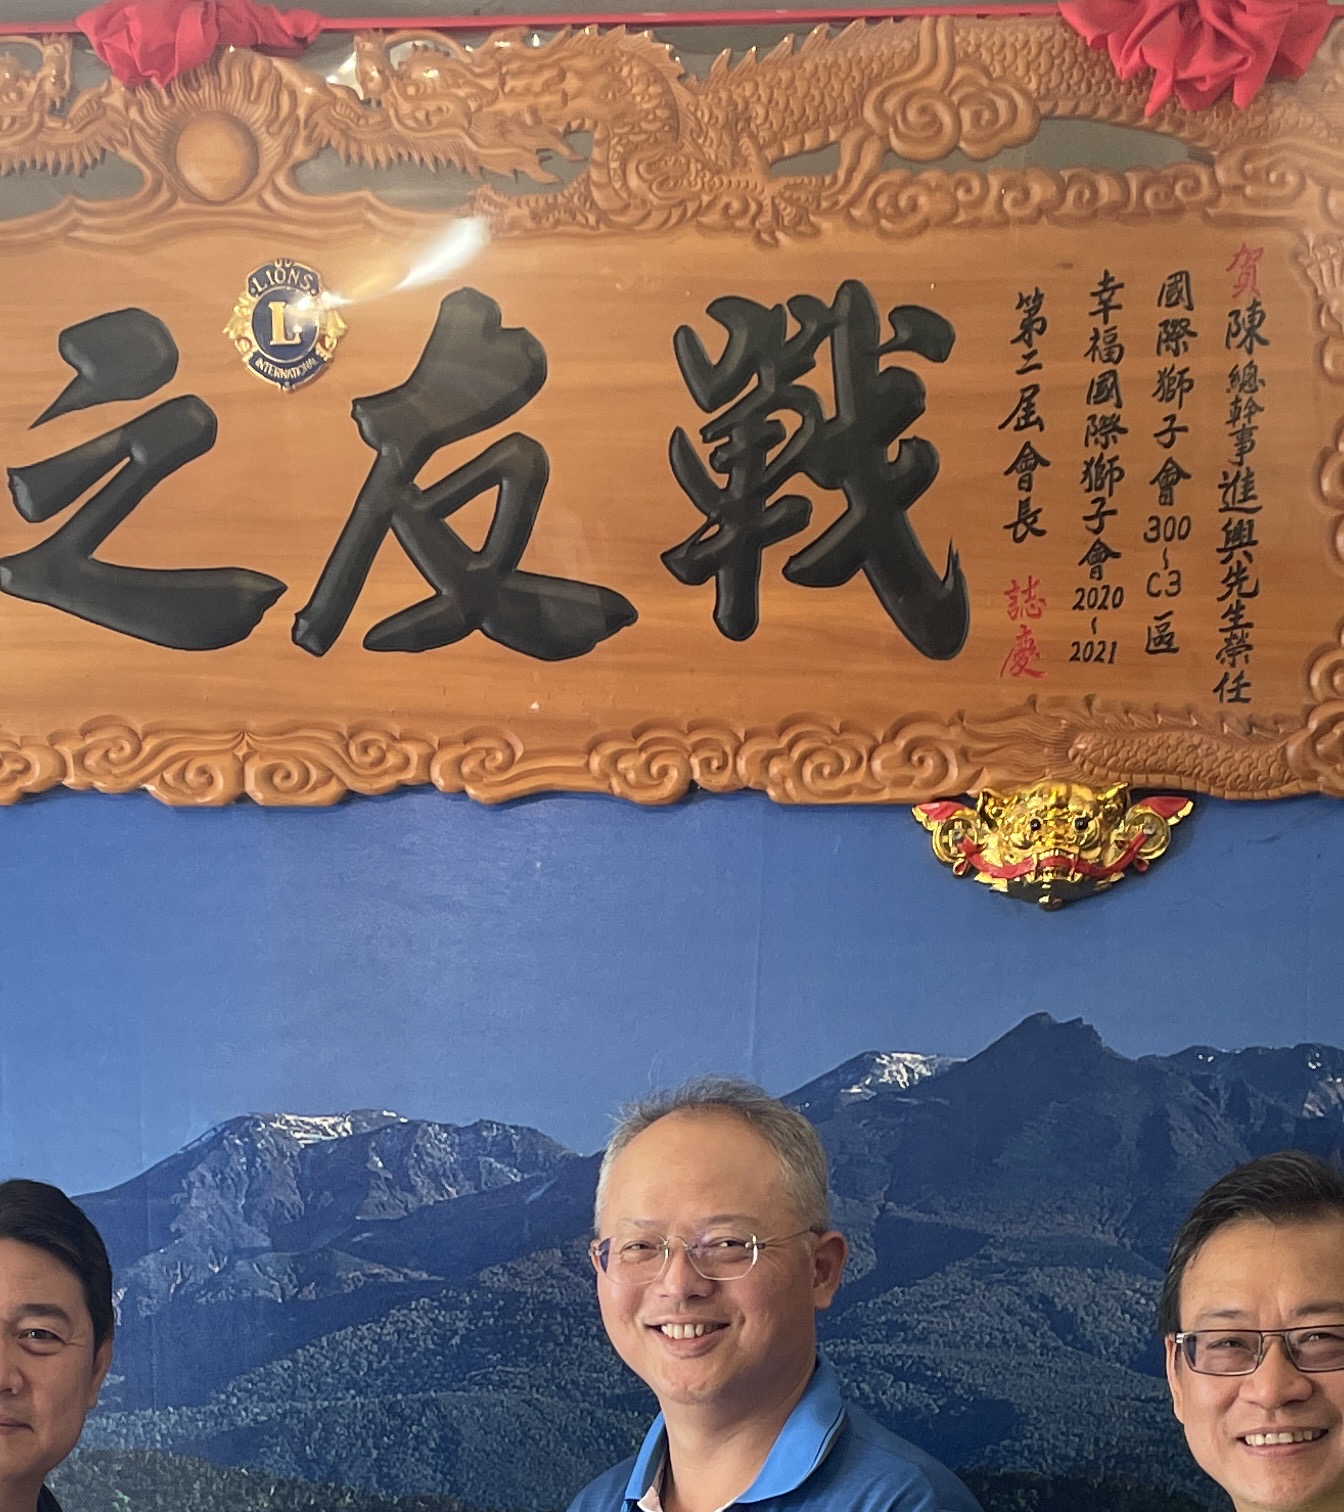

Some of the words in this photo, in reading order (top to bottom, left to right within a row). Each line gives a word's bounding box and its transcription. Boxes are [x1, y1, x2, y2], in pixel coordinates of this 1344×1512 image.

[252, 266, 314, 292] LIONS
[268, 301, 302, 346] L
[998, 286, 1051, 544] 第二屆會長
